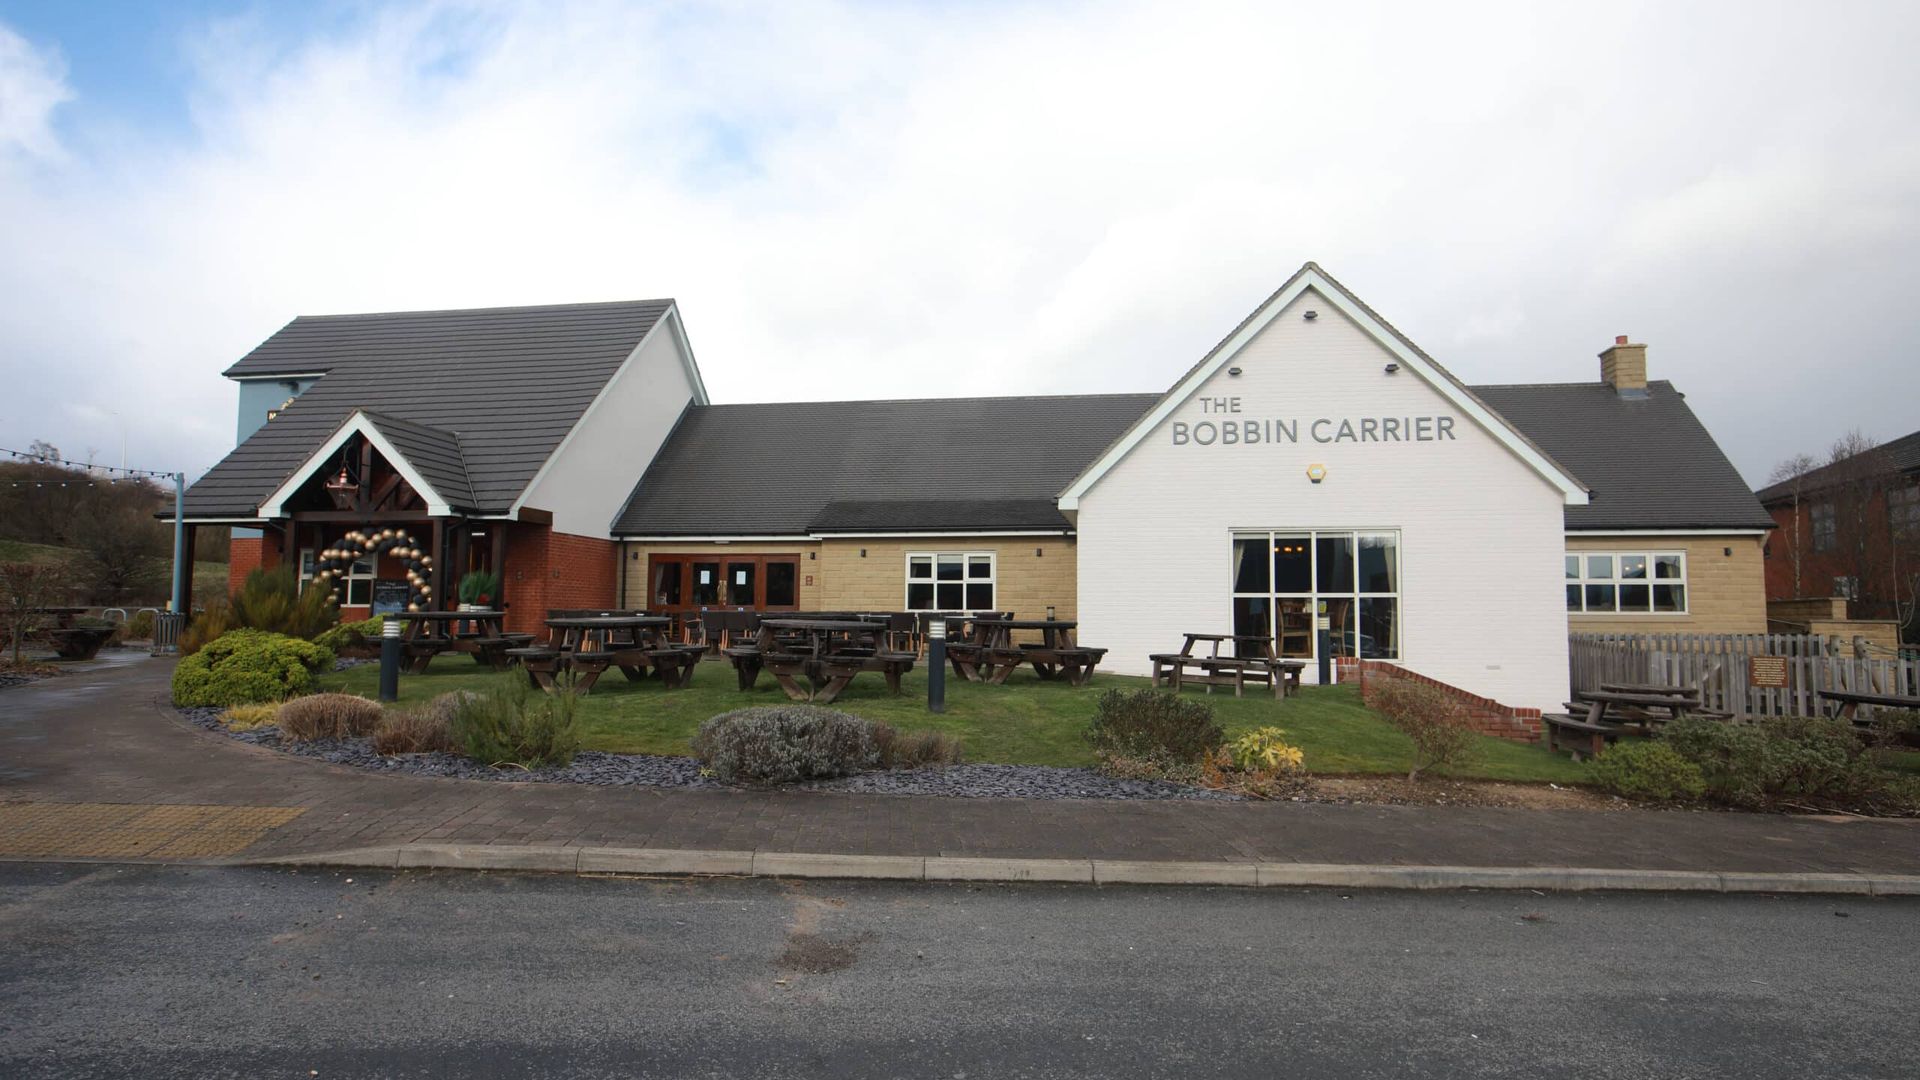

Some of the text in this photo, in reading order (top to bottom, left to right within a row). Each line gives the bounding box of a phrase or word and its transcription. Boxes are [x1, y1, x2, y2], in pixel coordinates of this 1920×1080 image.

[1199, 396, 1242, 413] THE
[1172, 416, 1457, 446] BOBBIN CARRIER
